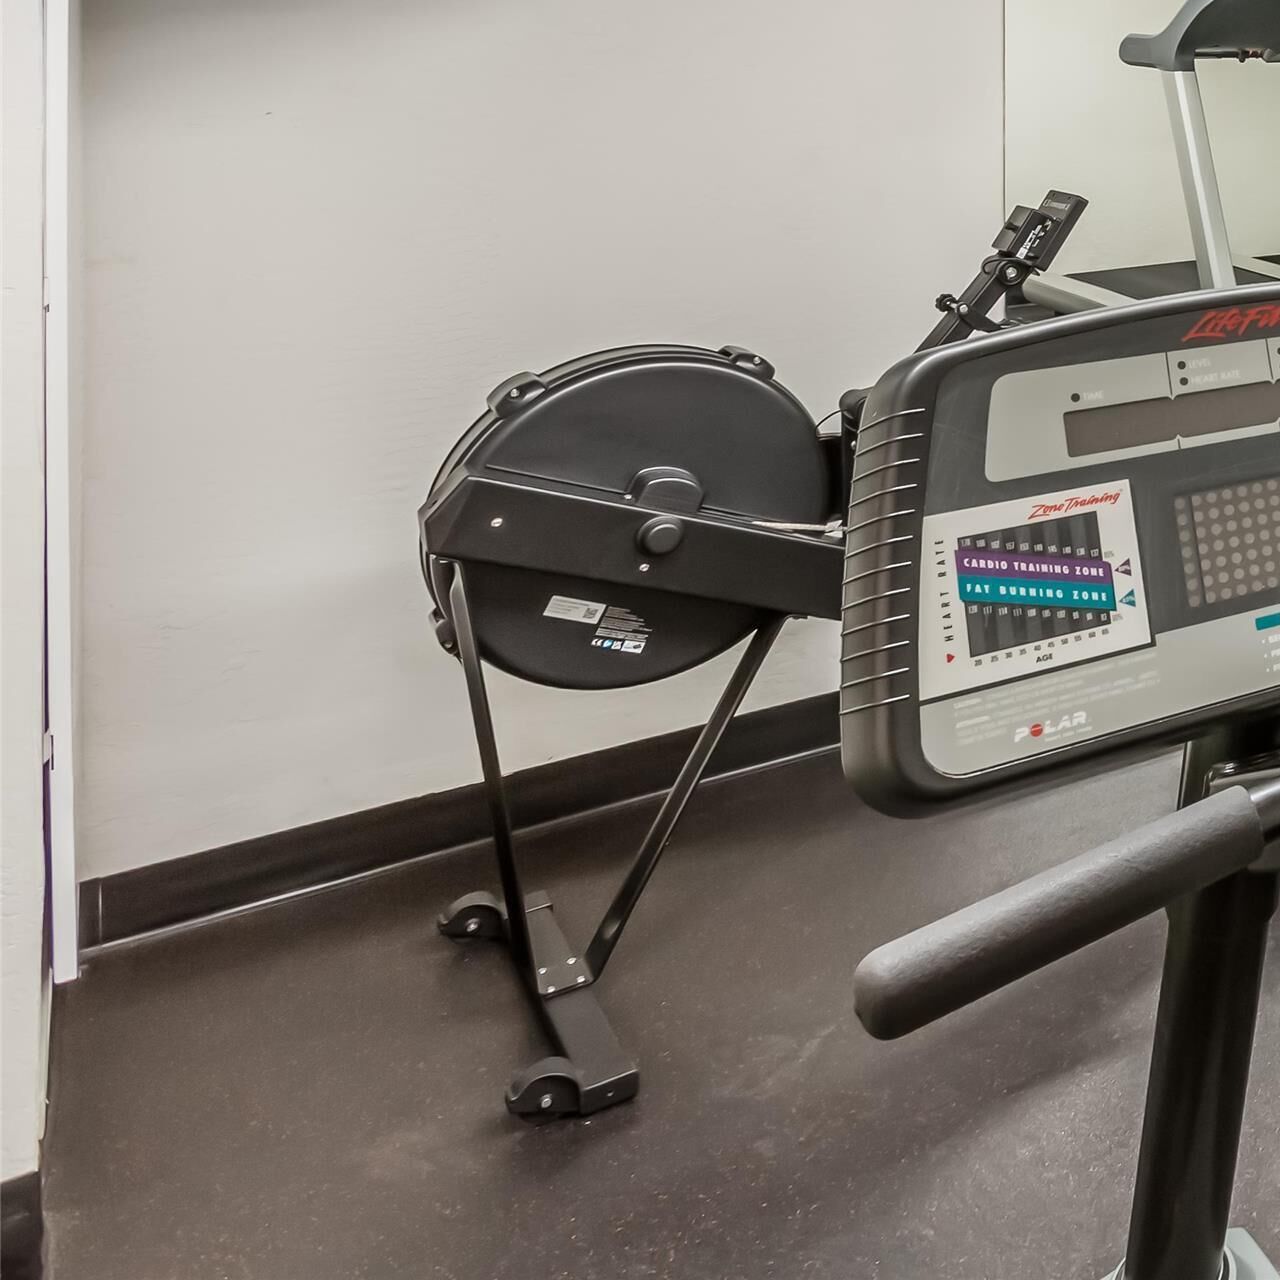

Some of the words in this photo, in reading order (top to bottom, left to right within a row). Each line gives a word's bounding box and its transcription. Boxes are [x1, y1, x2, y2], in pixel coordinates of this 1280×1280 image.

[1028, 503, 1064, 520] Zone
[1064, 491, 1121, 513] Training
[934, 539, 947, 578] RATE
[963, 558, 1008, 570] CARDIO
[1013, 562, 1070, 574] TRAINING
[1074, 566, 1104, 577] ZONE
[966, 583, 990, 594] FAT
[999, 585, 1064, 598] BURNING
[1072, 590, 1107, 602] ZONE
[939, 591, 954, 642] HEART
[1036, 653, 1053, 663] AGE
[1014, 710, 1087, 743] POLAR
